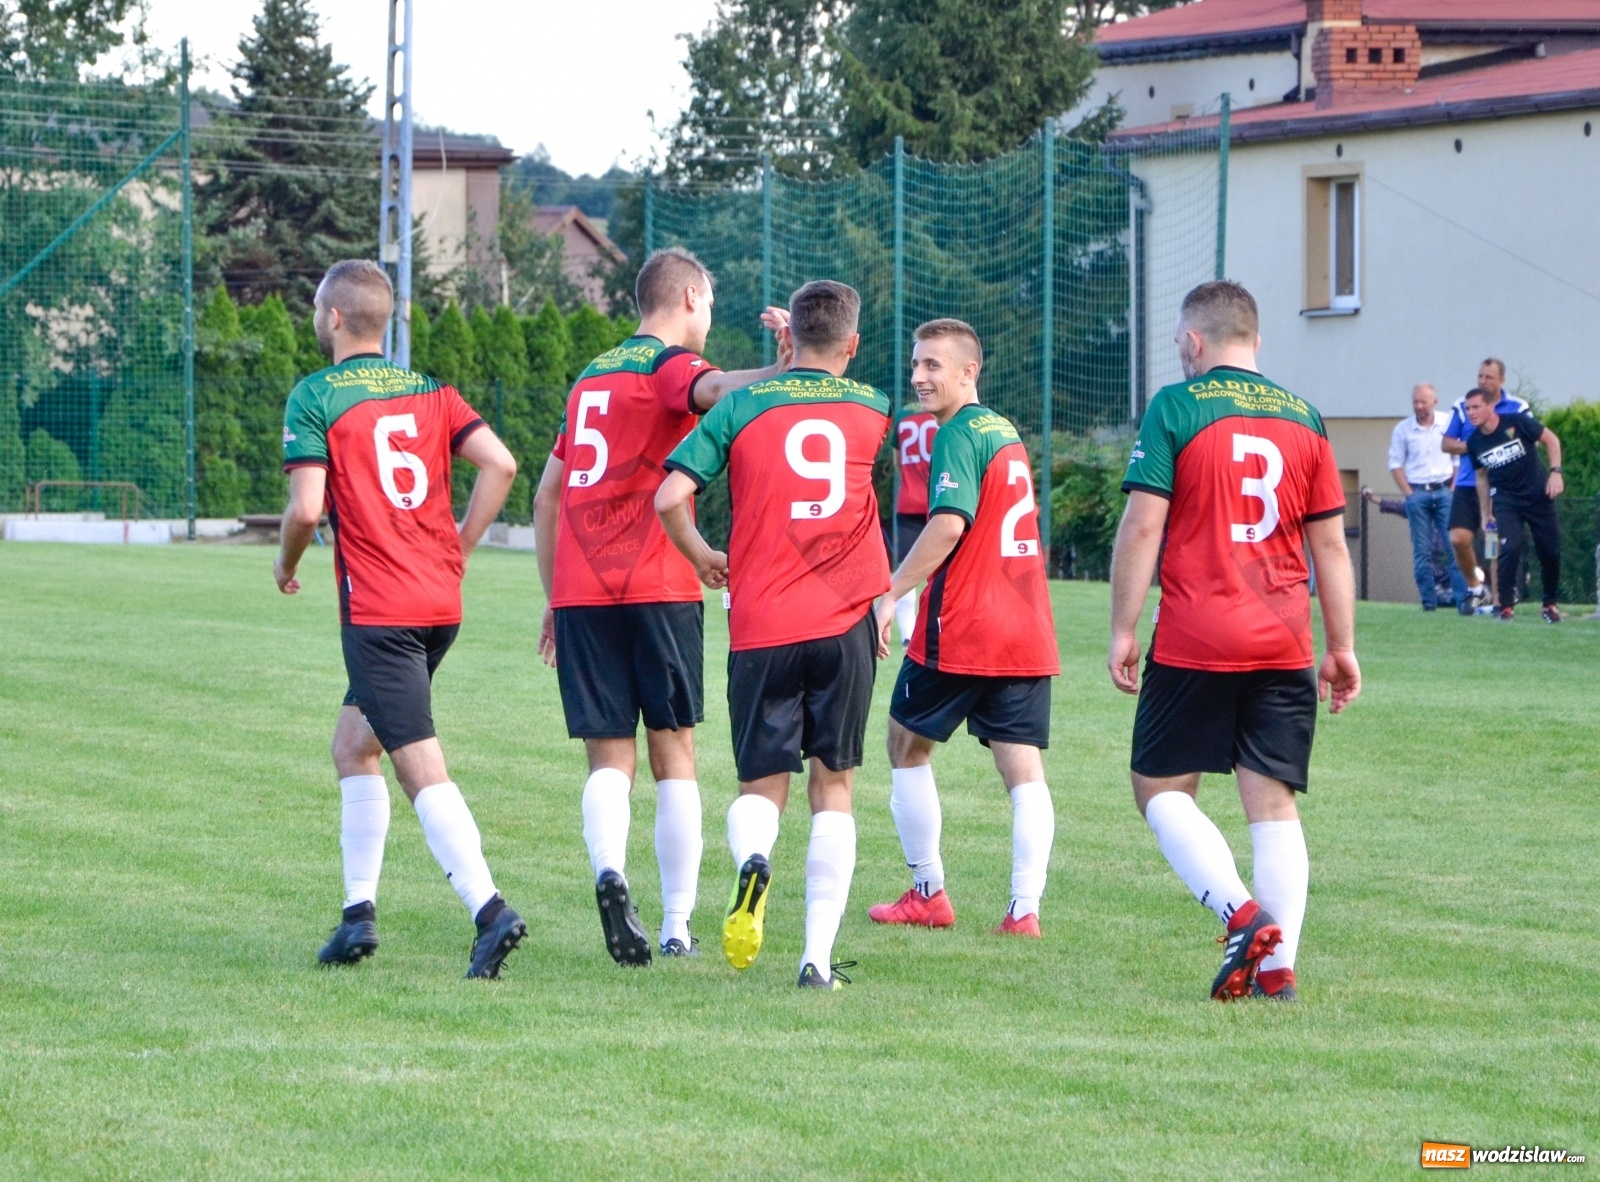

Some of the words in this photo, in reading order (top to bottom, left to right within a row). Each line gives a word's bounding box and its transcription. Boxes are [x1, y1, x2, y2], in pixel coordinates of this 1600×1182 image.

[748, 377, 875, 394] GARDENIA
[752, 385, 806, 396] PRACOWNIA
[789, 391, 842, 399] GORZYCZKI
[1188, 379, 1310, 411] GARDENIA
[1195, 389, 1247, 402] PRACOWNIA
[1248, 396, 1309, 417] FLORYSTYCZNA
[1234, 399, 1281, 413] GORZYCZKI
[568, 390, 612, 488] 5
[898, 419, 940, 466] 20
[374, 413, 429, 510] 6
[785, 418, 847, 520] 9
[1231, 432, 1285, 543] 3
[583, 499, 645, 532] CZARNI
[1001, 459, 1039, 558] 2
[587, 539, 642, 559] GORZYCE
[828, 560, 881, 585] GORZYCE
